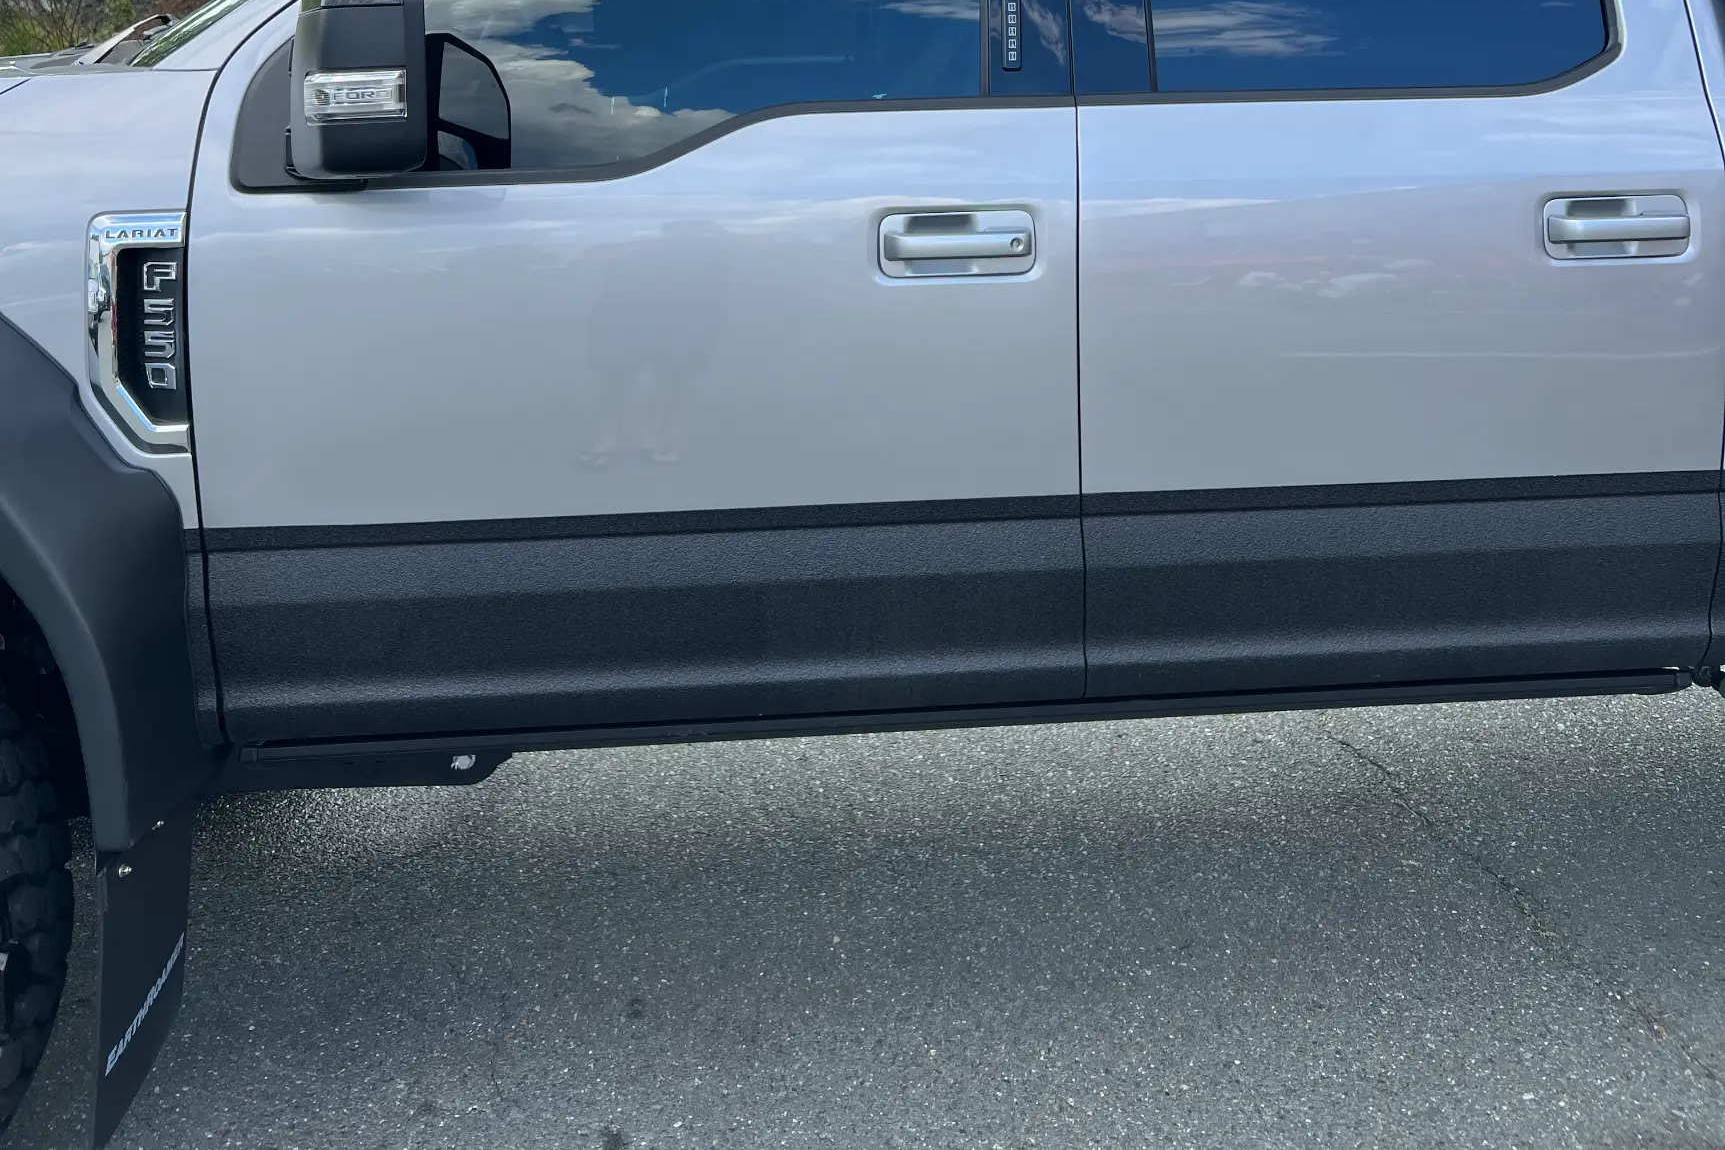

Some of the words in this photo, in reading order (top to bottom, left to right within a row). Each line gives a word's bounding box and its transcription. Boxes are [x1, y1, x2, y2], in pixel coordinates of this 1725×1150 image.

[332, 89, 394, 101] FORD
[106, 228, 178, 239] LARIAT
[143, 261, 178, 390] F550
